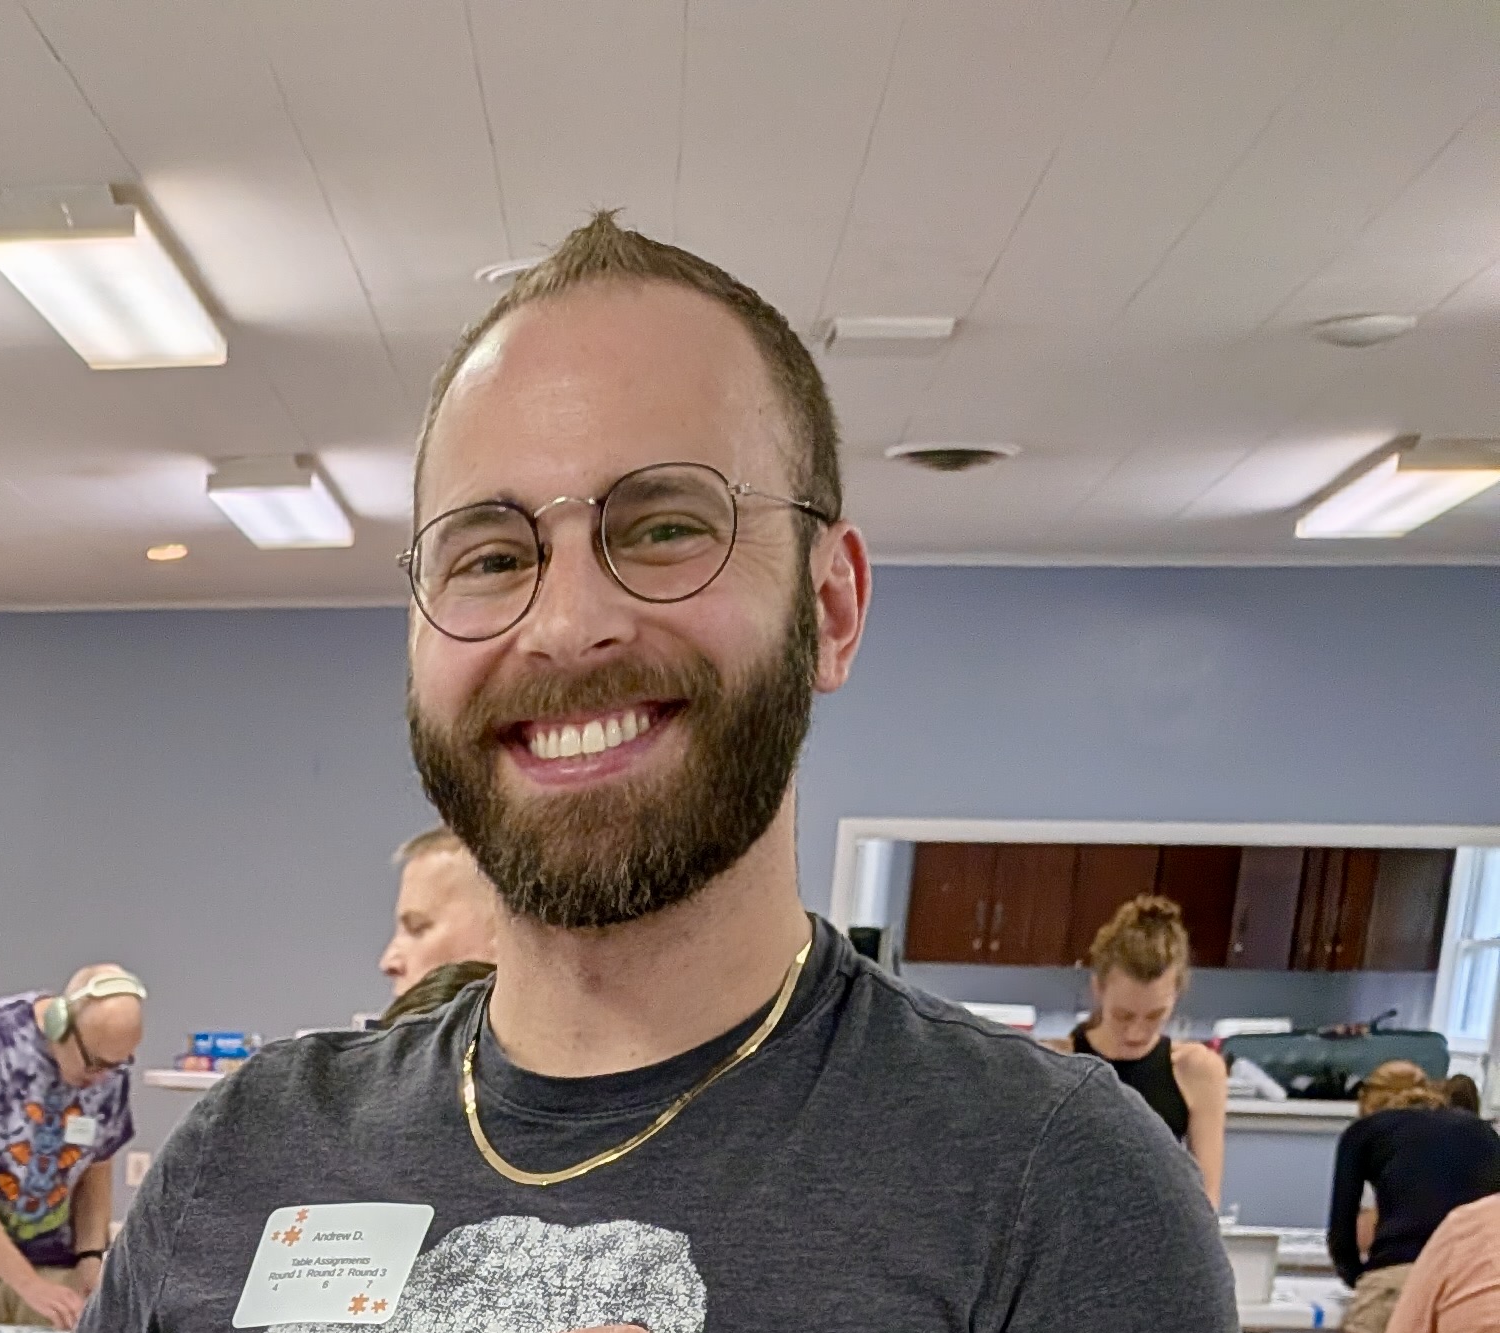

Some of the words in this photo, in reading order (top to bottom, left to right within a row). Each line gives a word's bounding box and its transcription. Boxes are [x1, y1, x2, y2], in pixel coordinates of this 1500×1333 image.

[312, 1231, 351, 1242] Andrew
[352, 1231, 364, 1241] D.
[291, 1258, 313, 1267] Table
[314, 1257, 371, 1267] Assignments
[268, 1270, 296, 1281] Round
[306, 1268, 335, 1278] Round
[336, 1268, 345, 1277] 2
[347, 1268, 379, 1277] Round
[379, 1268, 388, 1277] 3
[366, 1280, 374, 1289] 7
